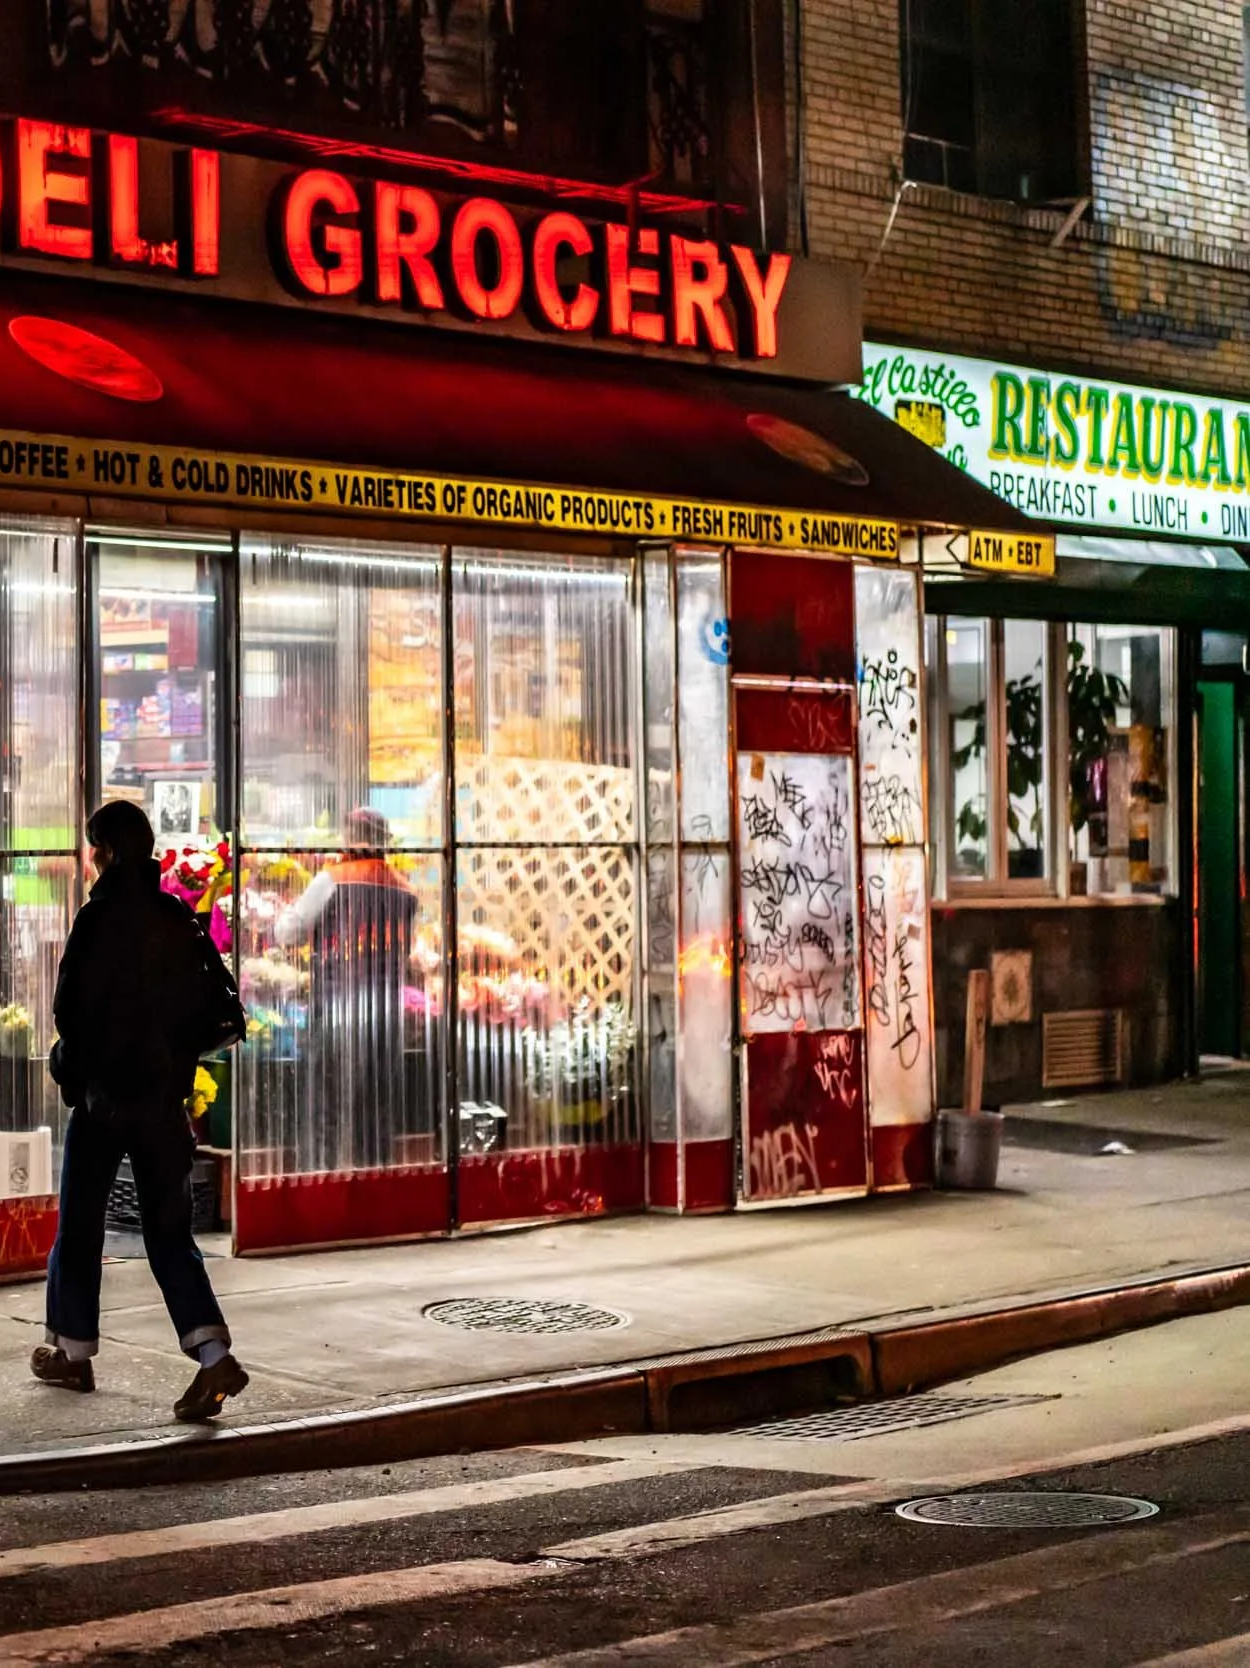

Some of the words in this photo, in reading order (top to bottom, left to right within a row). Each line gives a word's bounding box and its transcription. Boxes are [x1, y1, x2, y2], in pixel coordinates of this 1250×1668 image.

[283, 168, 792, 358] GROCERY
[888, 354, 981, 428] Castillo
[93, 449, 140, 484] HOT
[147, 455, 163, 488] &
[171, 458, 229, 494] COLD
[236, 464, 312, 501] DRINKS
[334, 473, 437, 512] VARIETIES
[443, 485, 467, 513] OF
[472, 486, 555, 522] ORGANIC
[560, 494, 655, 529] PRODUCTS
[672, 505, 723, 537] FRESH
[728, 511, 783, 543] FRUITS
[799, 521, 897, 552] SANDWICHES
[990, 471, 1099, 520] BREAKFAST
[1131, 490, 1189, 531] LUNCH
[973, 531, 1003, 562] ATM
[1016, 536, 1042, 566] EBT
